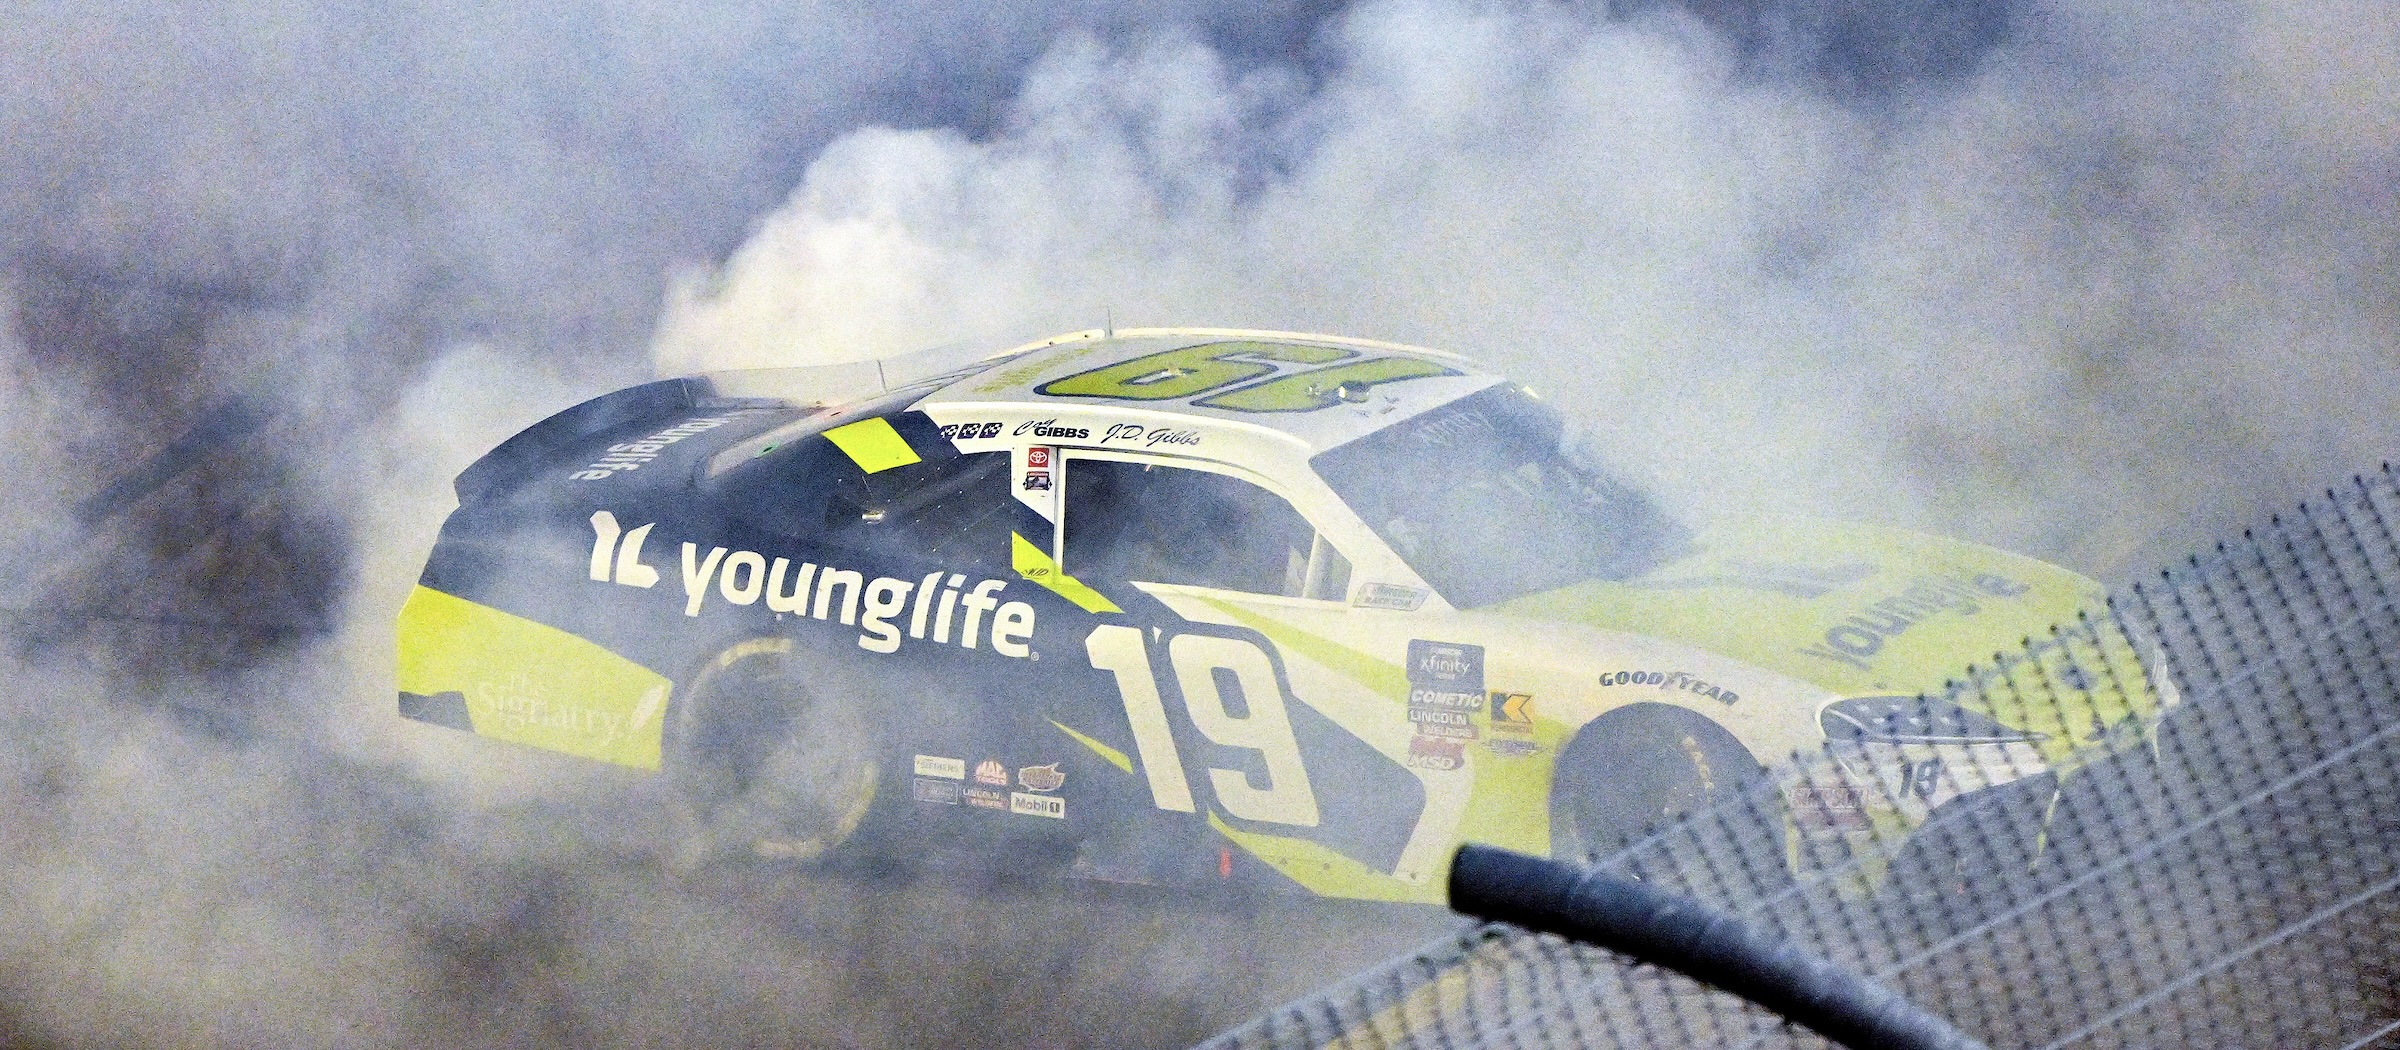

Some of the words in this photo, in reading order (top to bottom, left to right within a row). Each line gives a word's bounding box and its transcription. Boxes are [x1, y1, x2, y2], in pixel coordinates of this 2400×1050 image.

[1034, 426, 1090, 439] GIBBS
[1100, 423, 1141, 444] J.D.
[1146, 426, 1201, 447] Gibbs
[681, 541, 1036, 658] younglife
[1420, 654, 1470, 676] xfinity
[1410, 689, 1484, 708] COMETIC
[1598, 670, 1740, 707] GOODYEAR
[1085, 624, 1320, 827] 19
[1409, 709, 1468, 725] LINCOLN
[1015, 796, 1047, 813] Mobil
